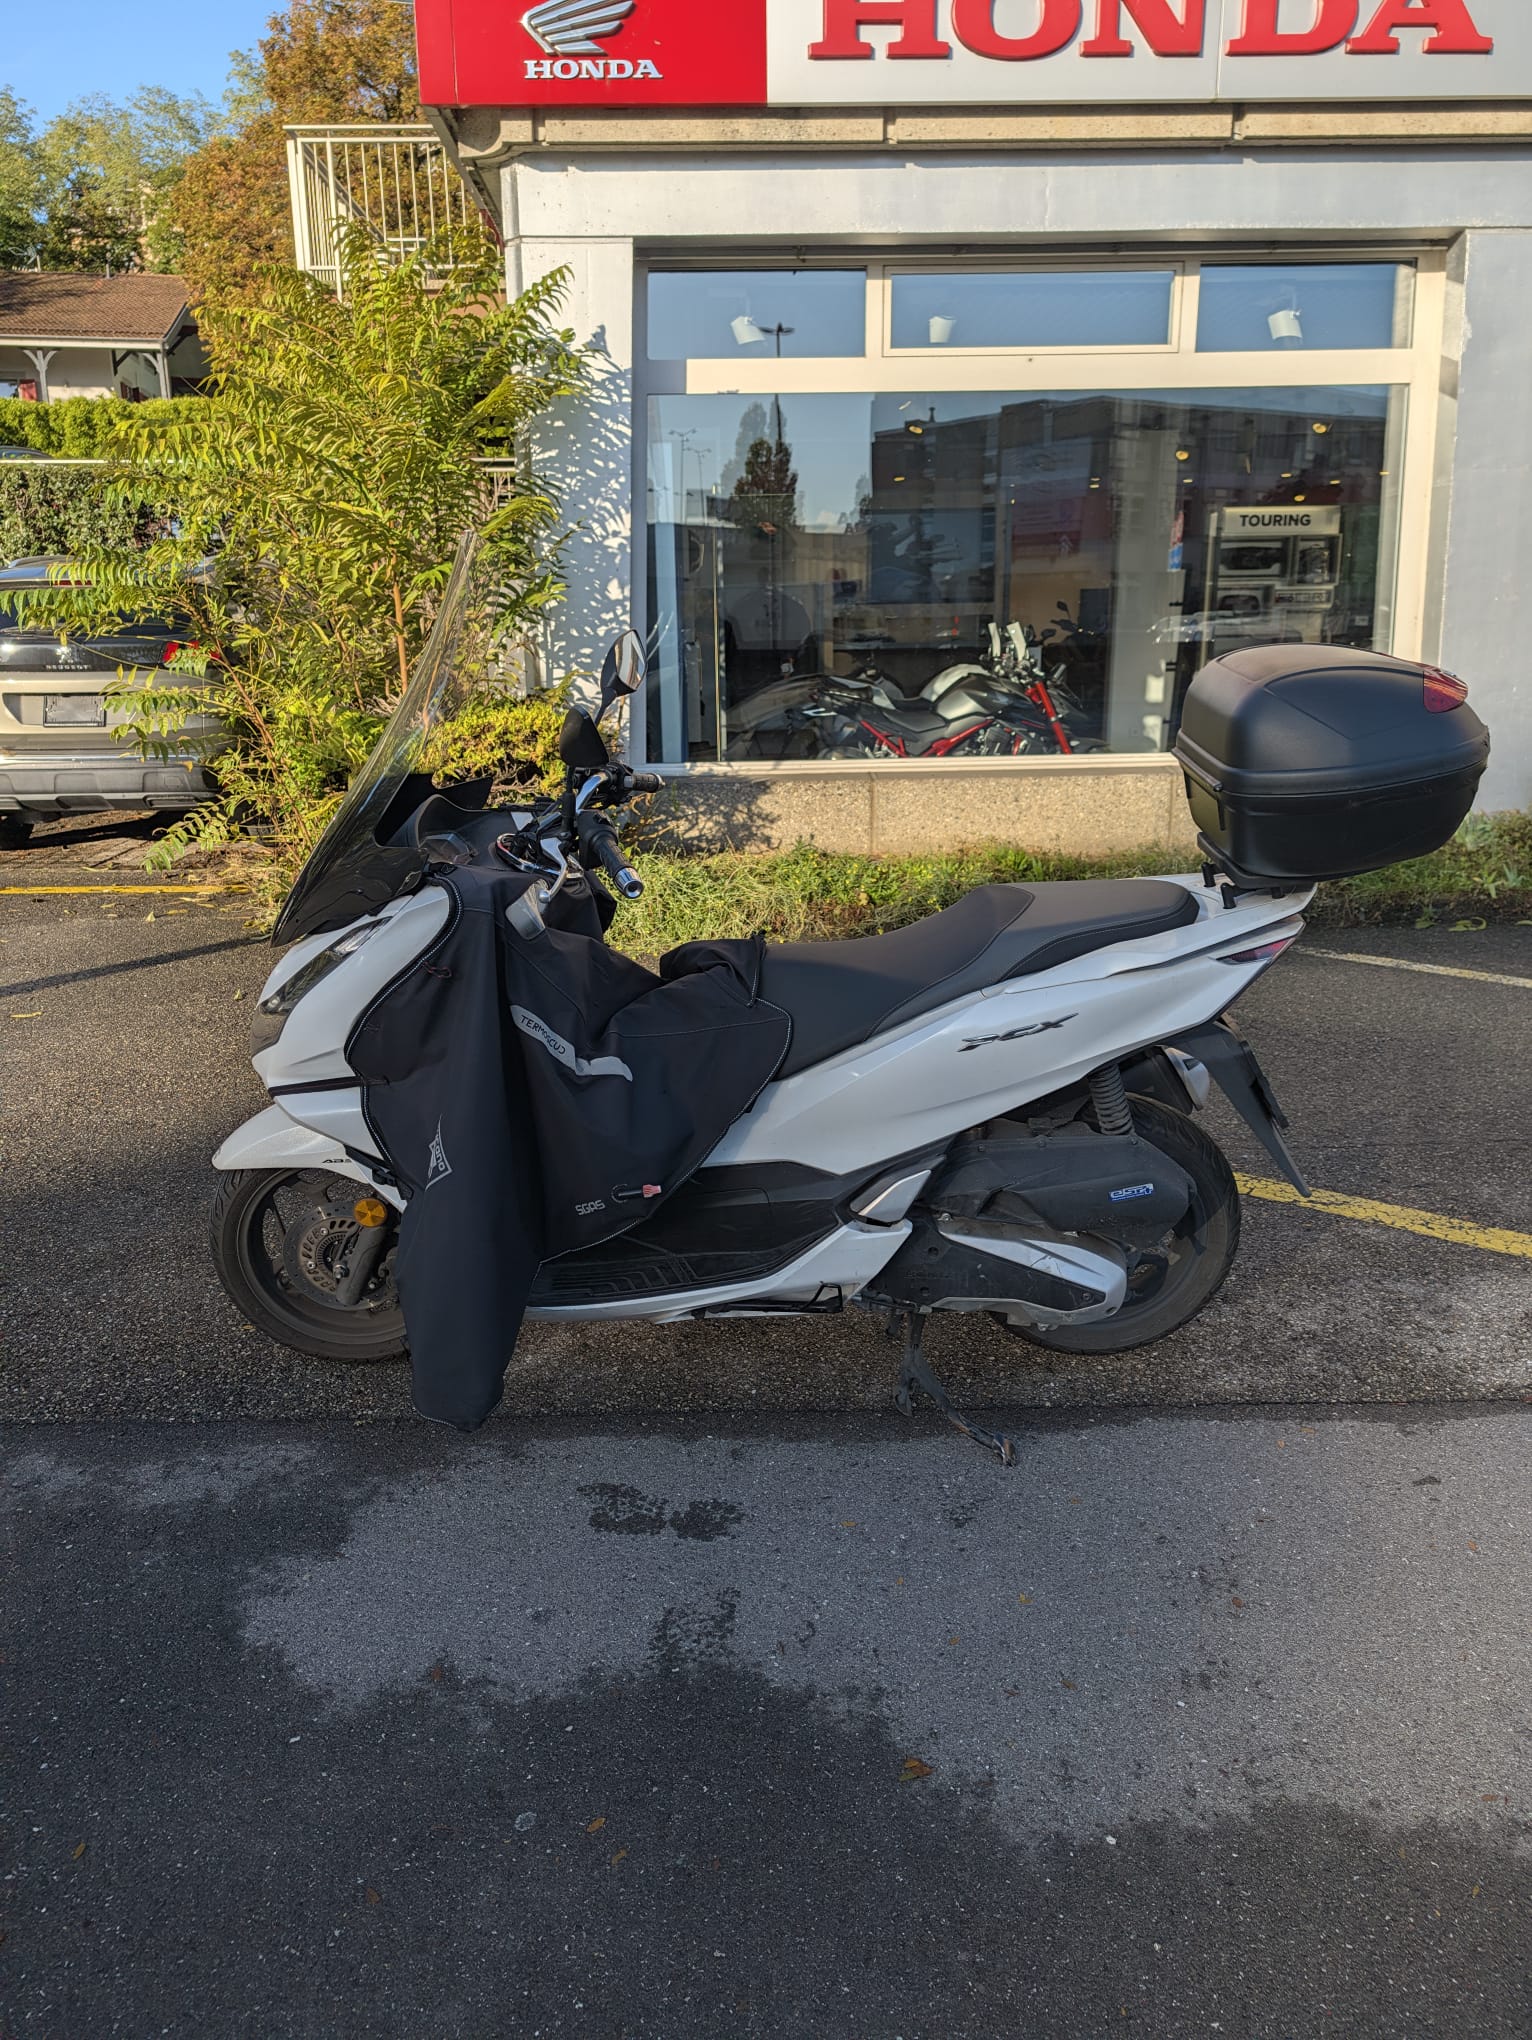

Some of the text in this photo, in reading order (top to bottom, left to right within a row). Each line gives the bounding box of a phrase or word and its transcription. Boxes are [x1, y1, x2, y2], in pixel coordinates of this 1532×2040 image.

[807, 0, 1494, 61] HONDA
[523, 59, 663, 80] HONDA
[1239, 513, 1312, 527] TOURING
